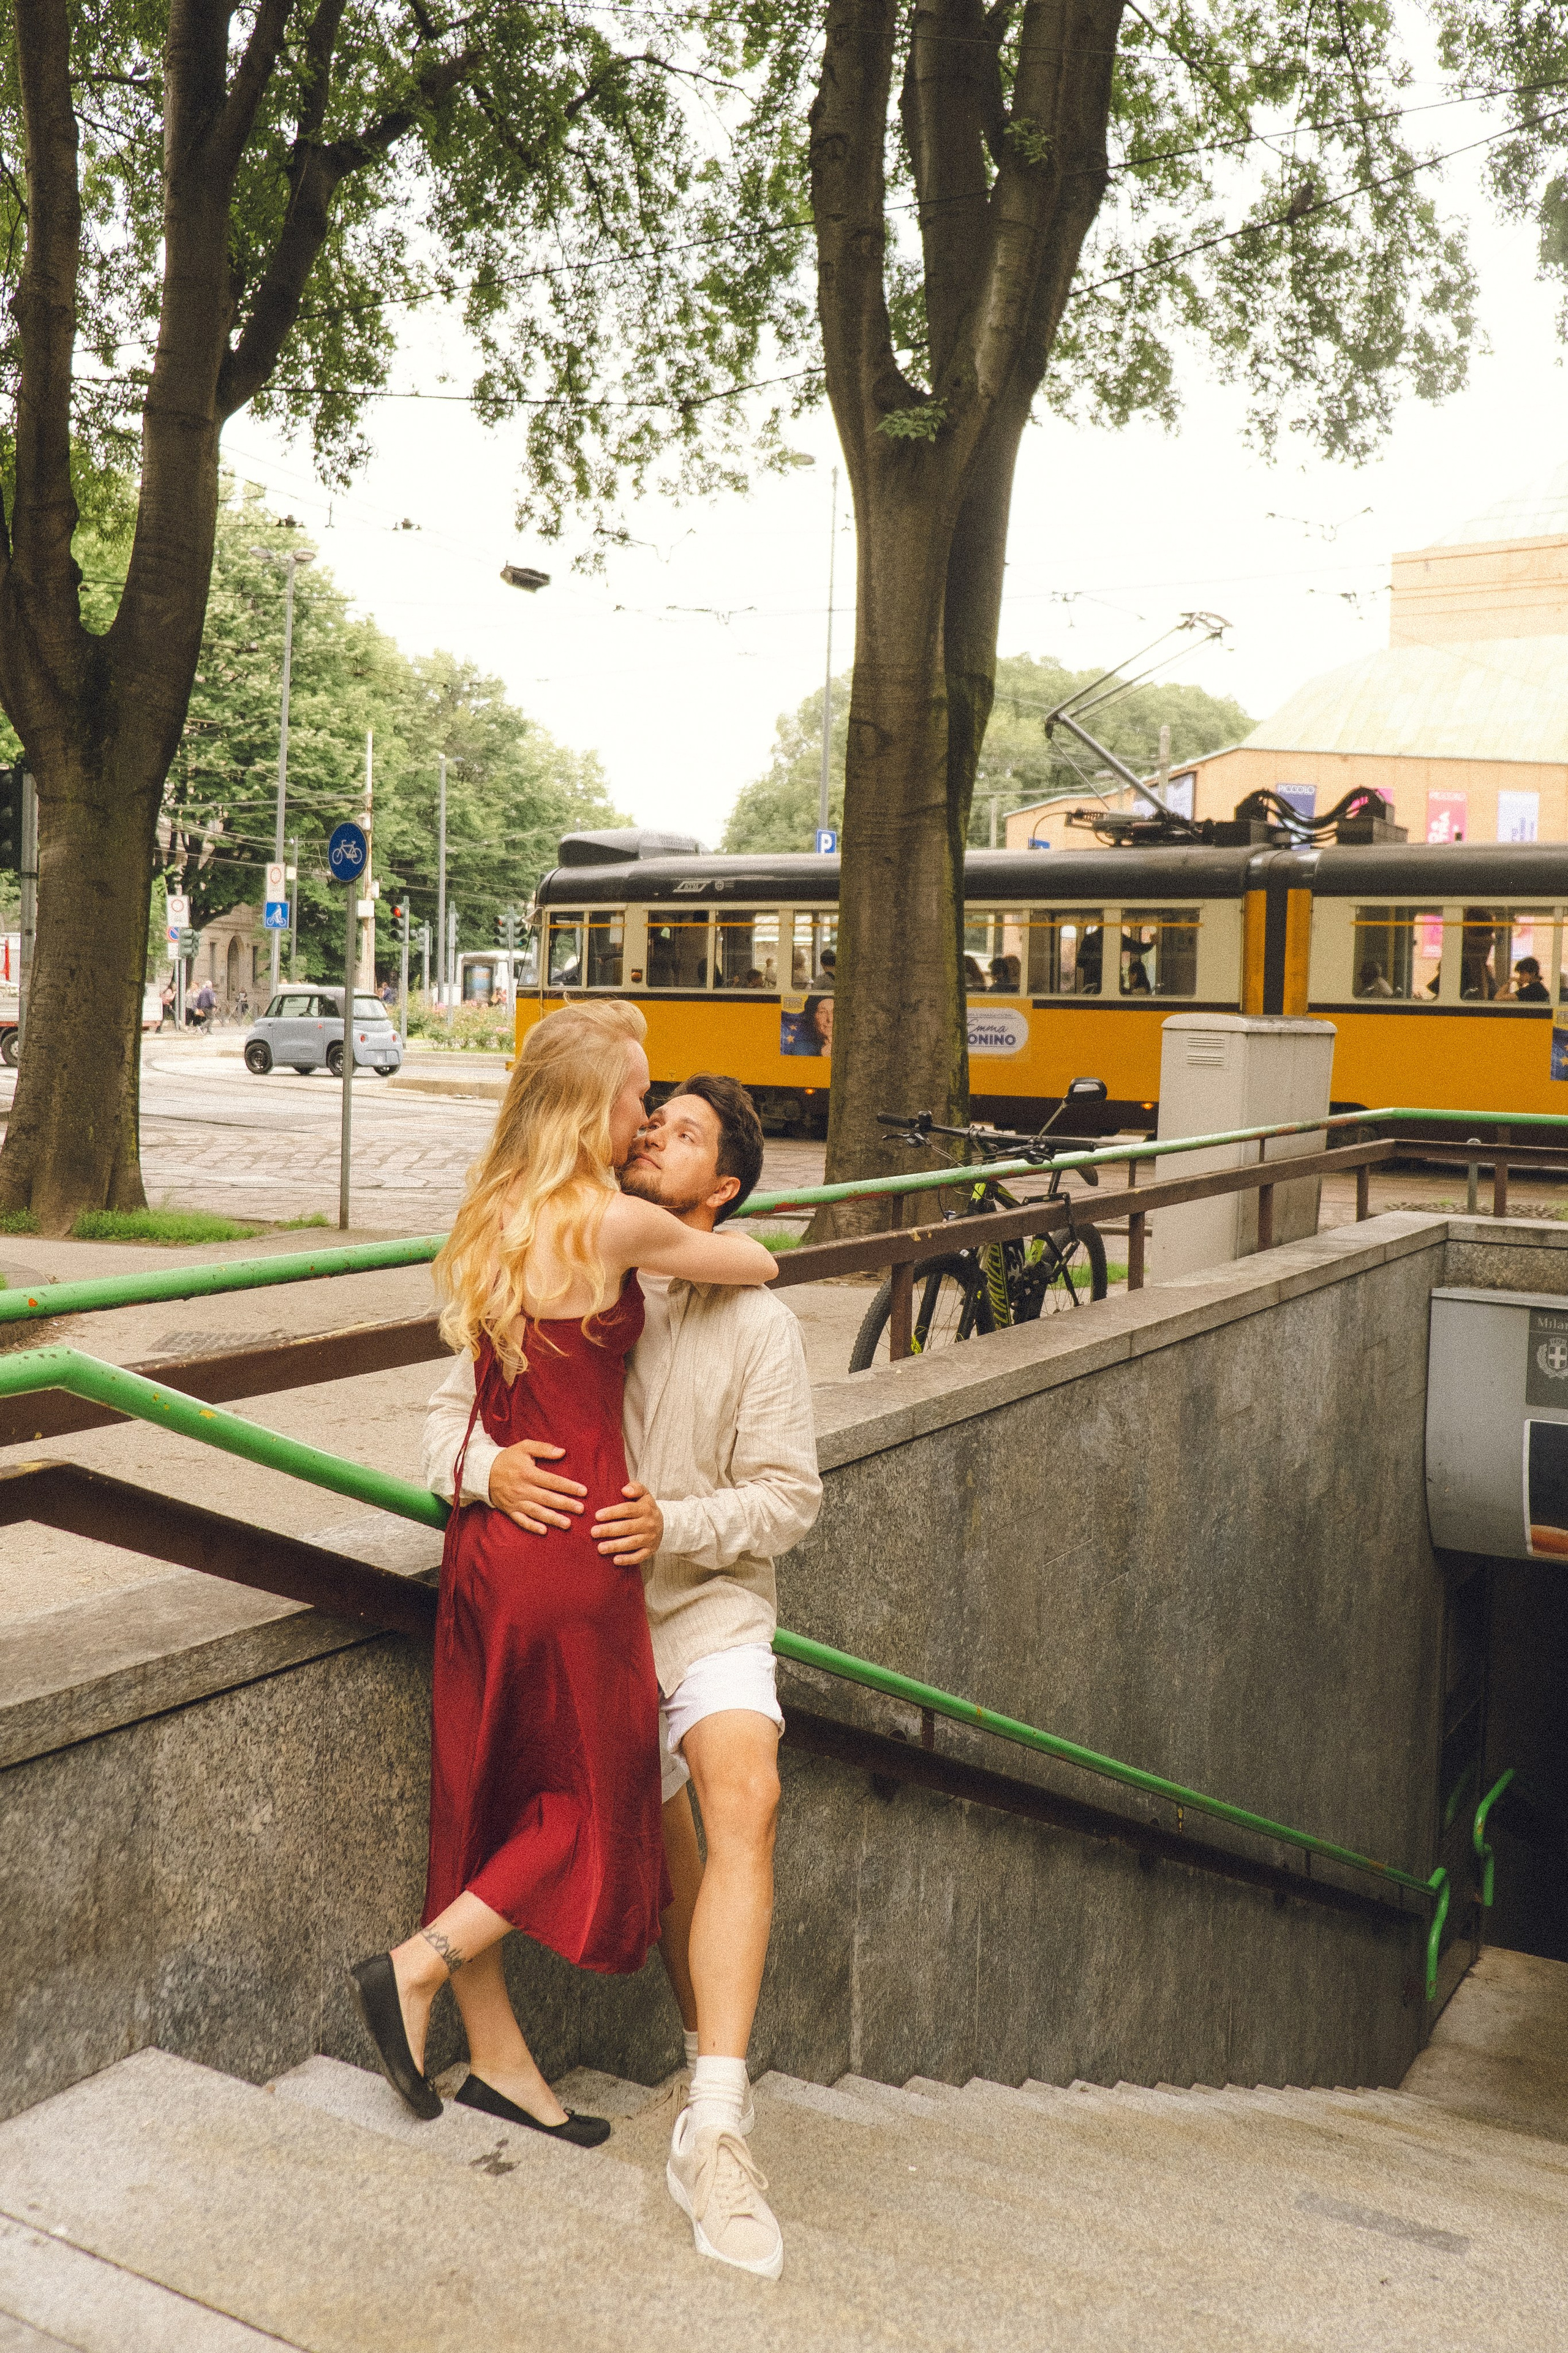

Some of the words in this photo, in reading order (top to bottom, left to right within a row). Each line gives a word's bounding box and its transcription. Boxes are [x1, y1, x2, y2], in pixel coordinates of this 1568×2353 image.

[1278, 785, 1315, 795] PICCOLO
[821, 833, 832, 853] P
[968, 1018, 1009, 1034] Emma
